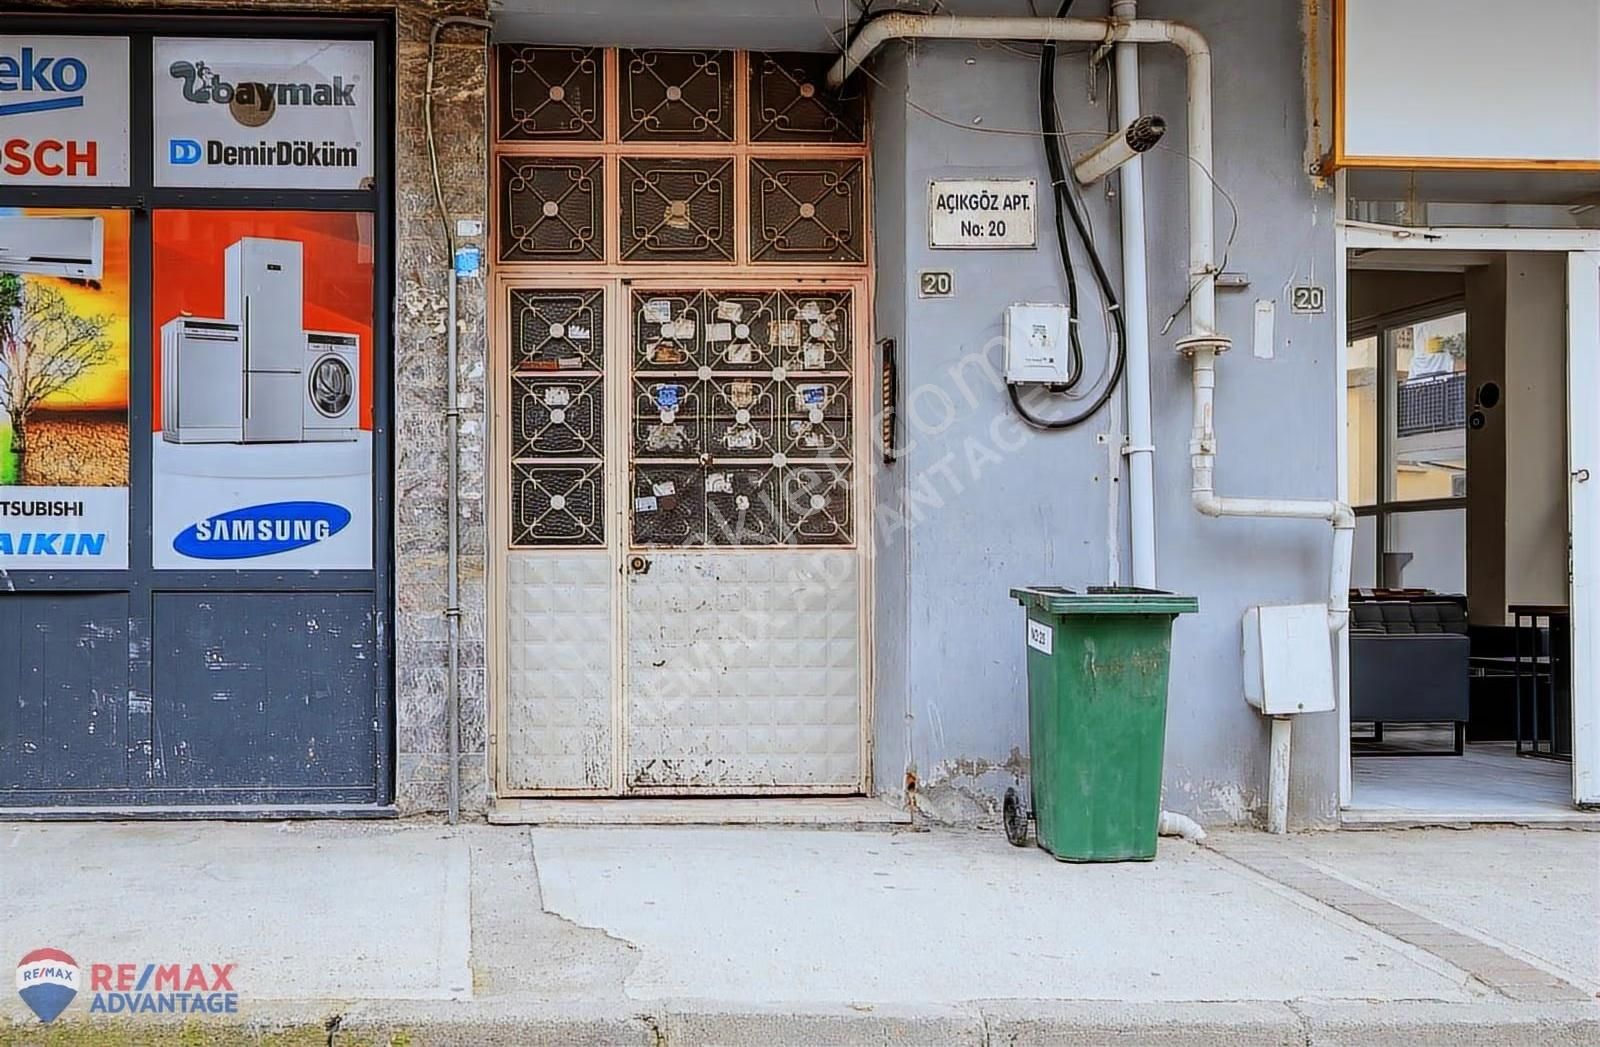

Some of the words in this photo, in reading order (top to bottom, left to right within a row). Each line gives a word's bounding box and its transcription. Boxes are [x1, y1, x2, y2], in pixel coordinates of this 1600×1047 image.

[211, 75, 356, 112] baymak
[0, 138, 97, 177] SCH
[207, 139, 358, 167] DemirDöküm
[936, 190, 999, 214] AÇIKGÖZ
[1002, 193, 1031, 211] APT.
[960, 220, 984, 237] No:
[988, 220, 1006, 237] 20
[923, 273, 950, 295] 20
[1296, 289, 1321, 308] 20
[0, 501, 84, 516] TSUBISHI
[196, 519, 330, 541] SAMSUNG
[0, 533, 106, 555] AIKIN
